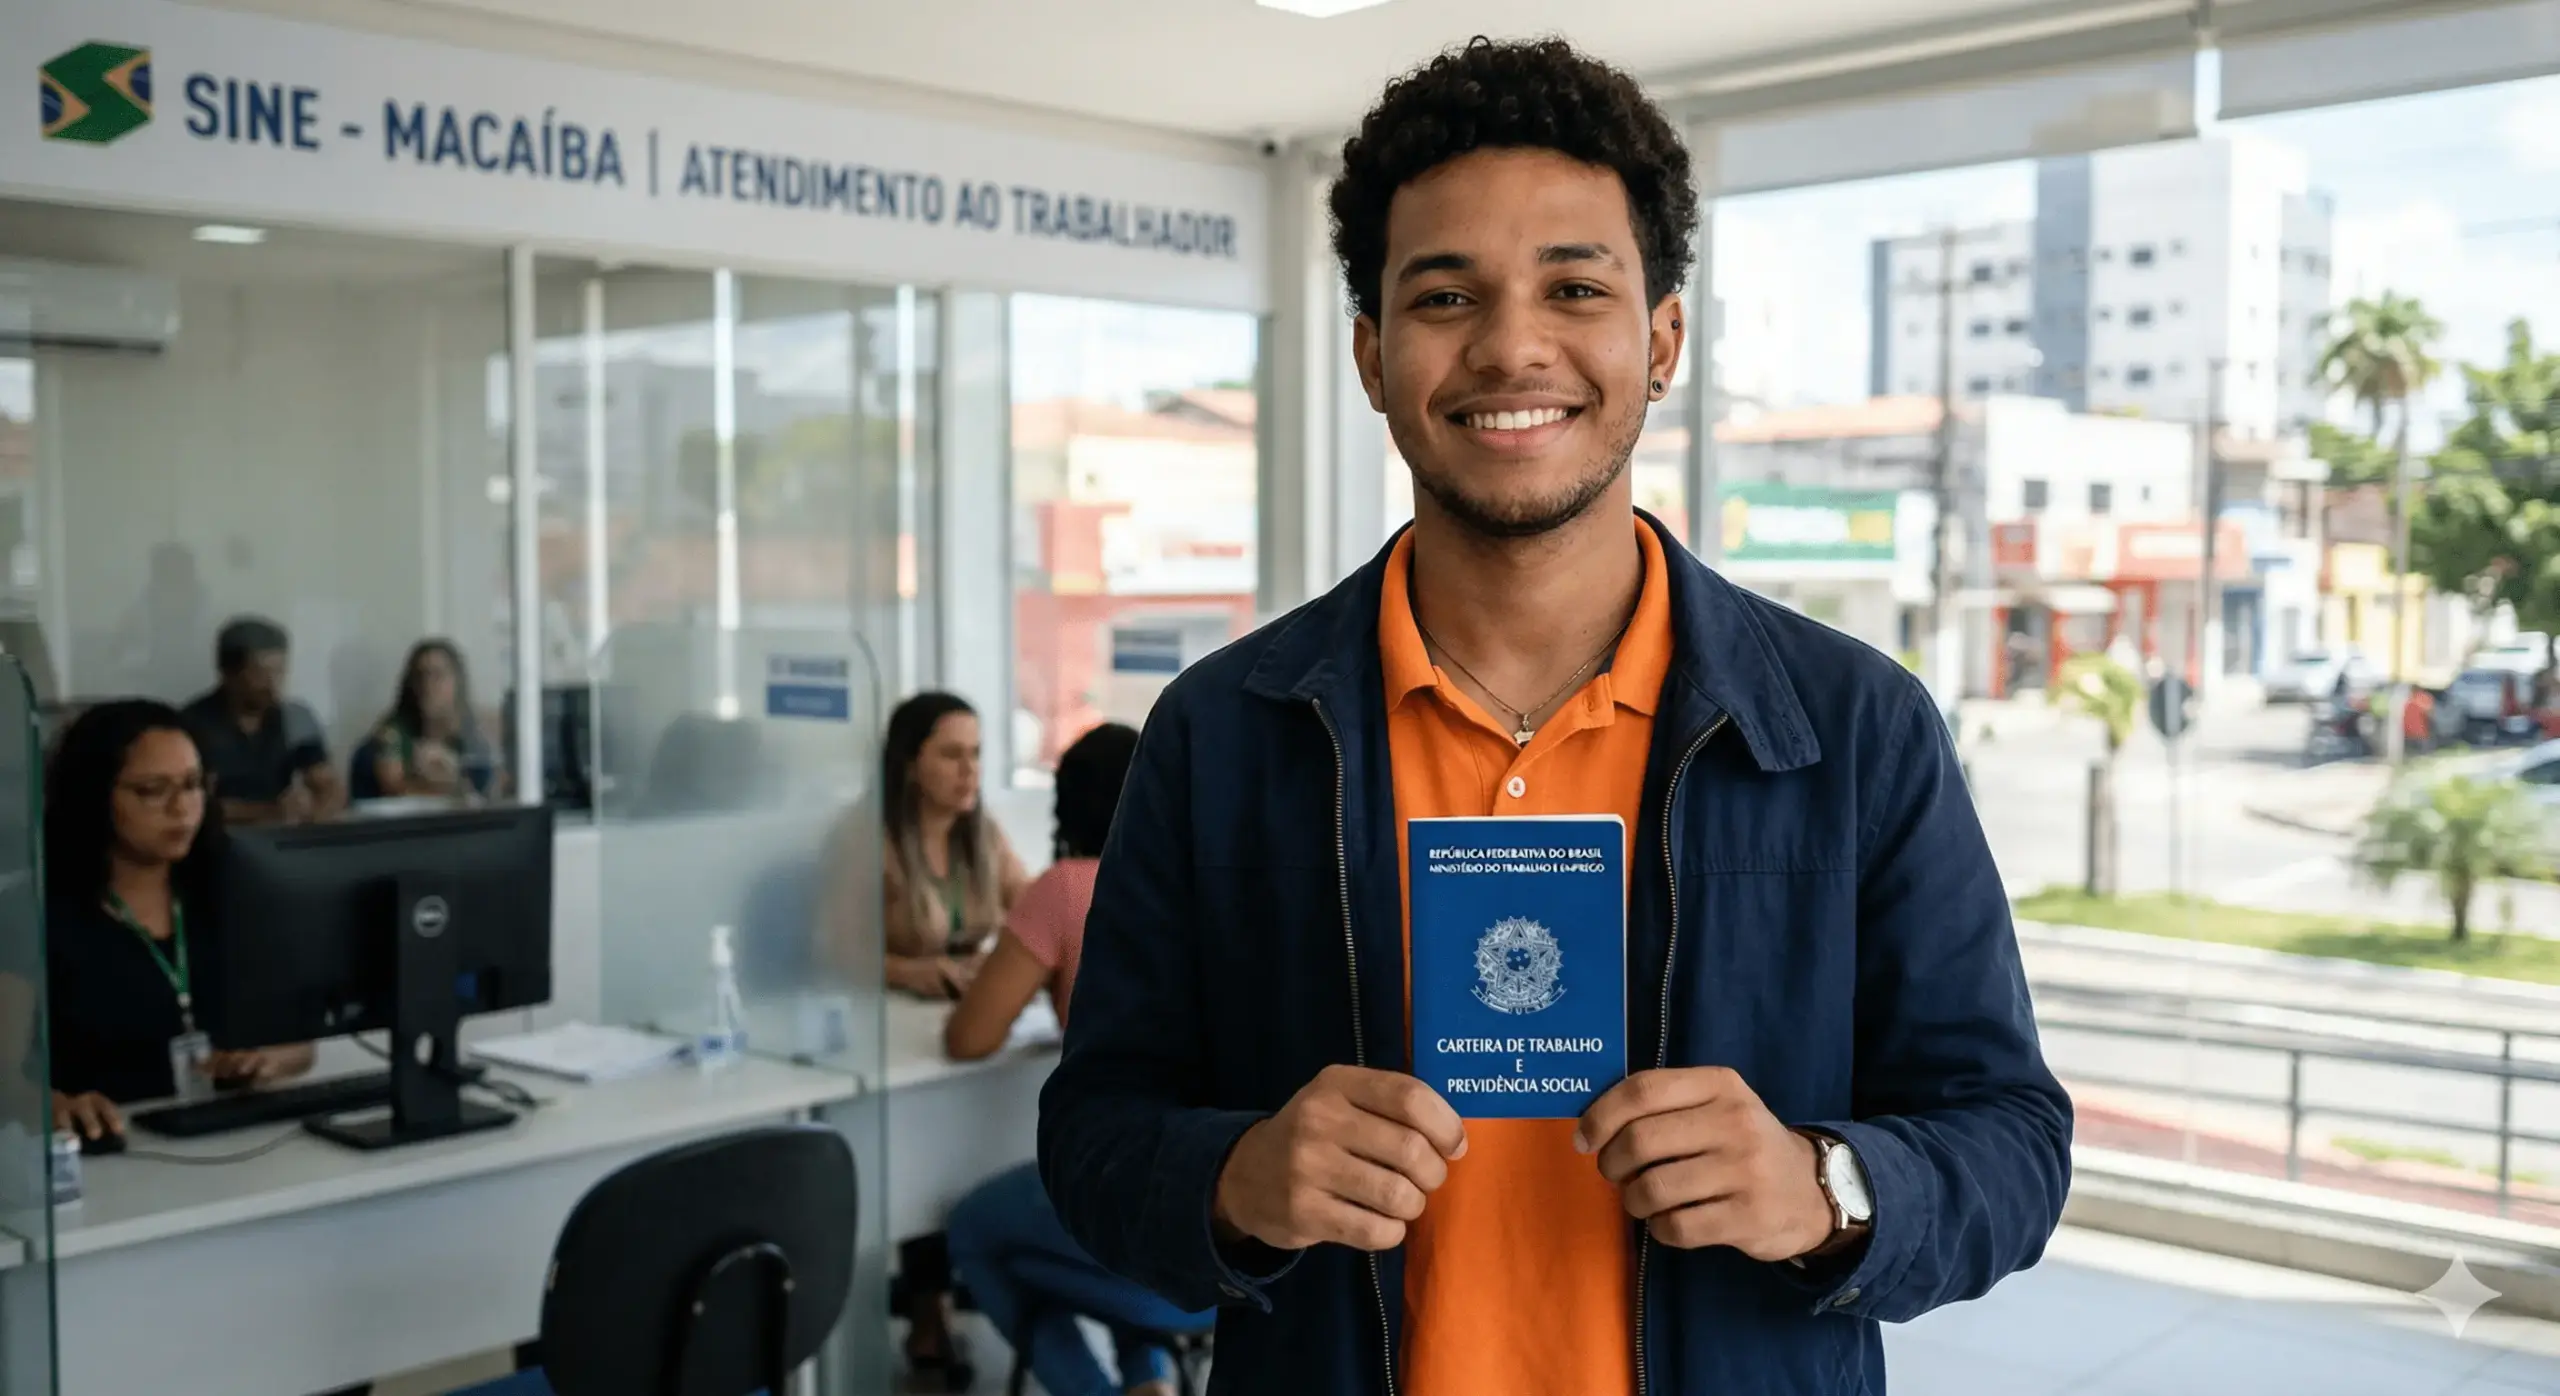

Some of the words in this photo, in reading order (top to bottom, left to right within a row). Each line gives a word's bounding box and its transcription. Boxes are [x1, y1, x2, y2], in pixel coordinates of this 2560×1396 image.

[184, 72, 321, 151] SINE
[383, 97, 625, 186] MACAÍBA
[680, 144, 944, 225] ATENDIMENTO
[955, 180, 1001, 231] AO
[1010, 184, 1238, 258] TRABALHADOR
[1429, 845, 1485, 859] REPÚBLICA
[1486, 848, 1547, 858] FEDERATIVA
[1549, 848, 1566, 858] DO
[1568, 848, 1602, 858] BRASIL
[1485, 863, 1500, 873] DO
[1502, 863, 1551, 873] TRABALHO
[1437, 1038, 1503, 1053] CARTEIRA
[1506, 1038, 1525, 1053] DE
[1528, 1037, 1603, 1053] TRABALHO
[1516, 1058, 1524, 1073] E
[1447, 1074, 1539, 1093] PREVIDÊNCIA
[1541, 1078, 1592, 1093] SOCIAL
